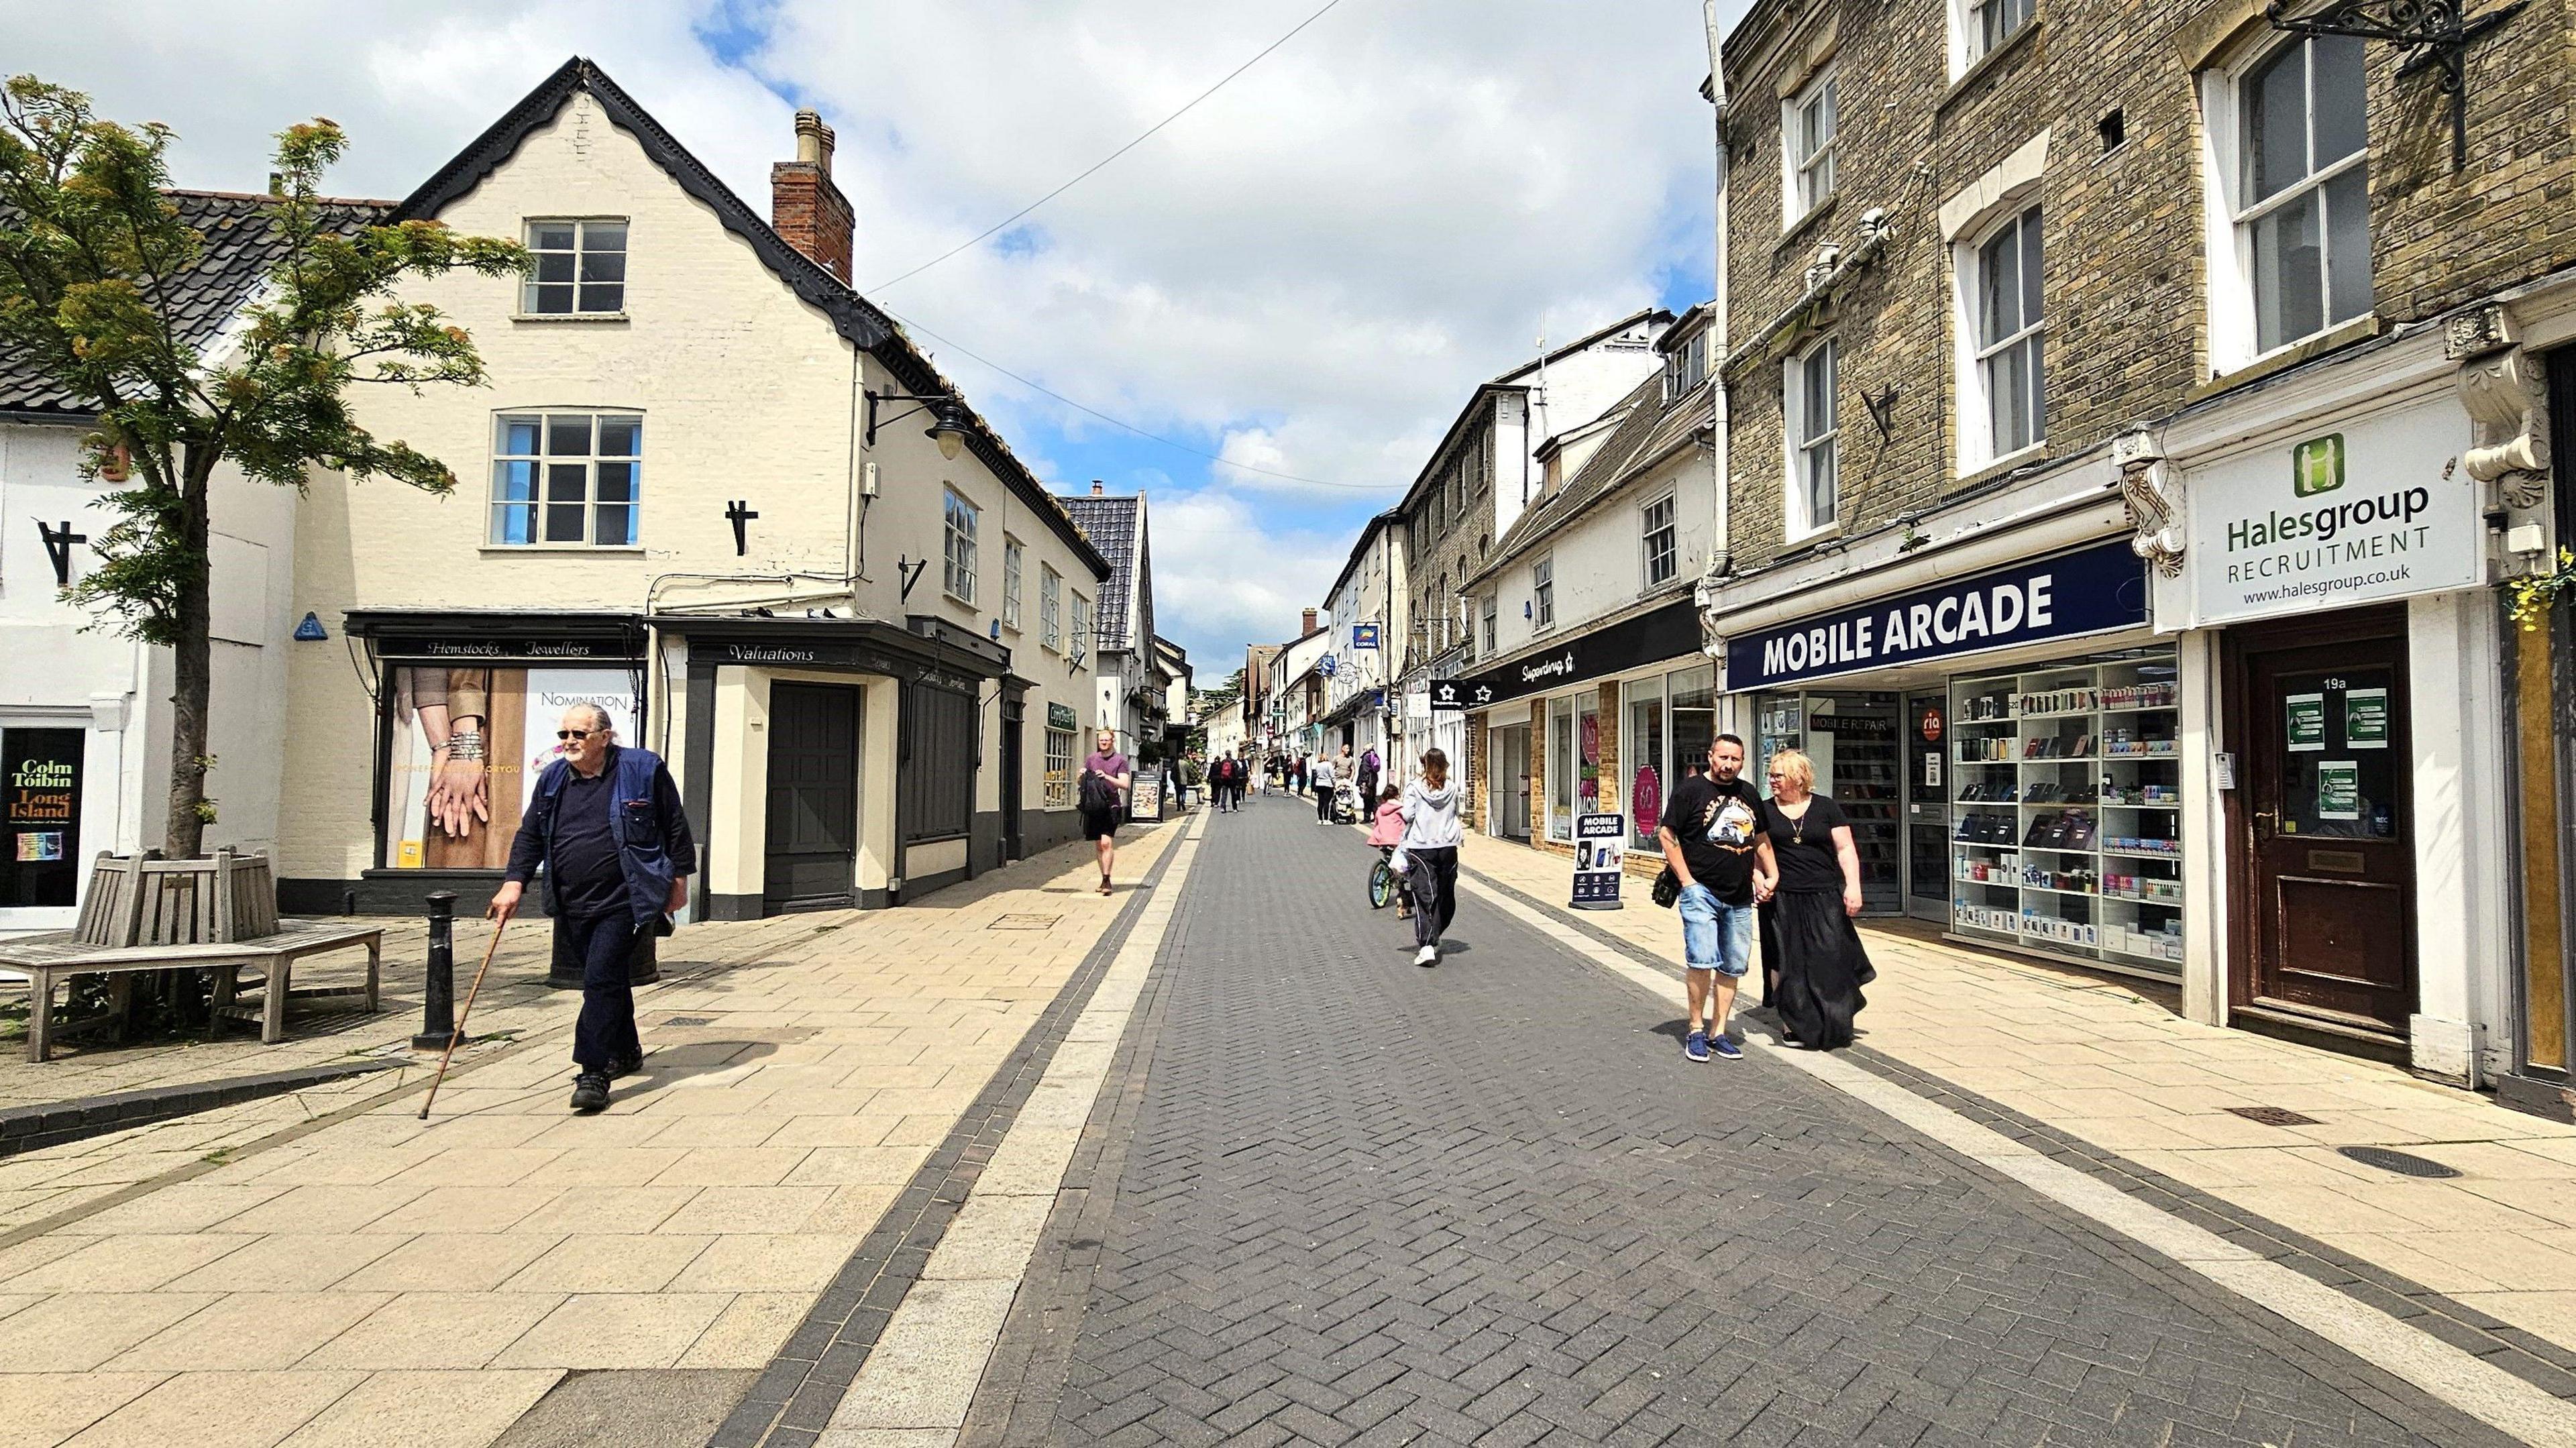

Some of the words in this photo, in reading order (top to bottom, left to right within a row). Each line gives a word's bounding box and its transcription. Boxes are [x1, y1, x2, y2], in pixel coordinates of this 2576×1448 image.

[2228, 486, 2429, 552] Halesgroup
[2228, 526, 2430, 583] RECRUITMENT
[2243, 564, 2411, 604] www.halesgroup.co.uk
[1762, 616, 1872, 677] MOBILE
[1882, 574, 2053, 655] ARCADE
[428, 641, 500, 655] Hemstocks
[525, 641, 590, 655] Jewellers
[730, 645, 814, 661] Valuations
[1523, 660, 1564, 683] Superdrug
[2324, 678, 2346, 689] 19a
[1923, 712, 1940, 729] ria
[22, 759, 72, 774] Colm
[11, 773, 71, 787] Tóibín
[21, 789, 71, 805] Long
[1640, 785, 1653, 810] 60
[10, 803, 70, 818] Island
[1584, 817, 1618, 826] MOBILE
[1582, 826, 1619, 835] ARCADE
